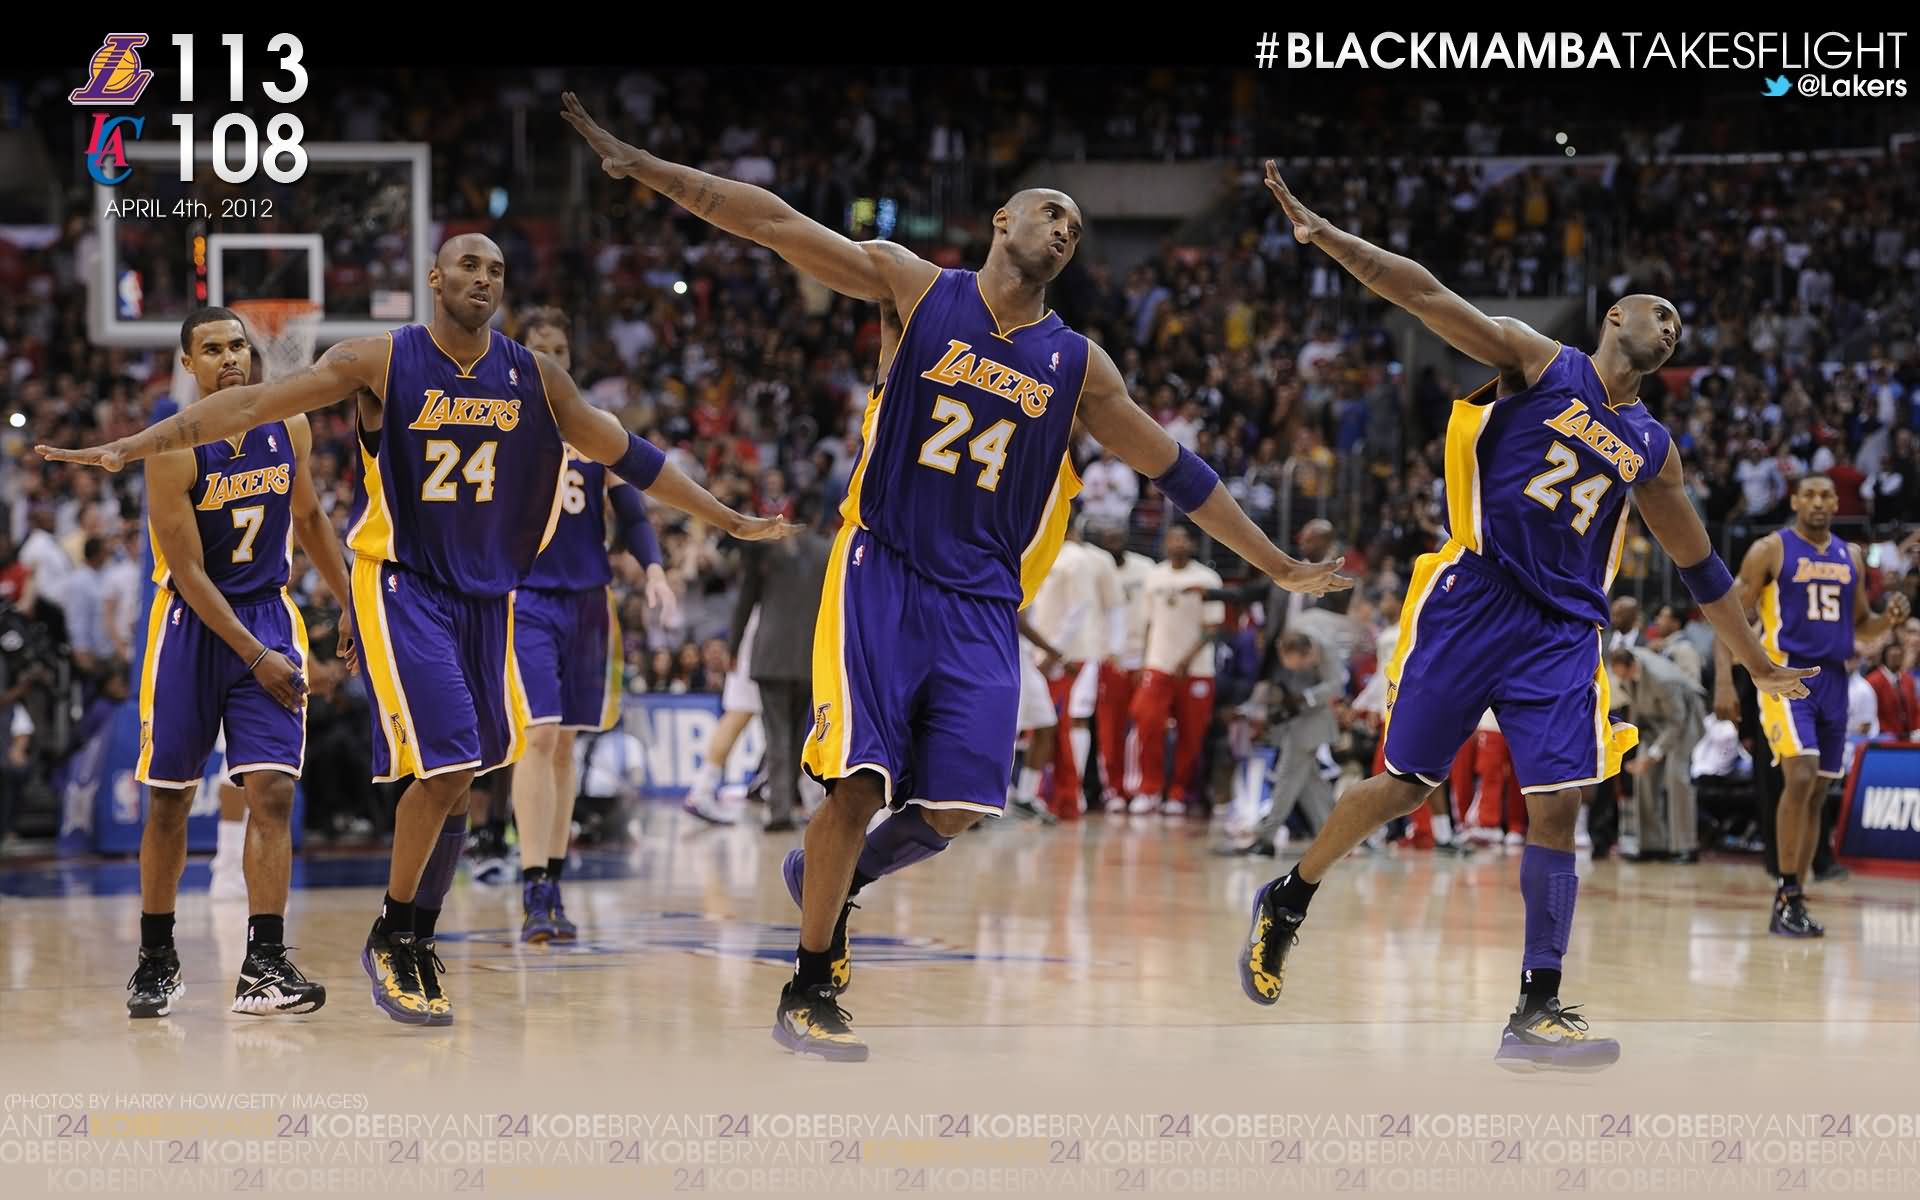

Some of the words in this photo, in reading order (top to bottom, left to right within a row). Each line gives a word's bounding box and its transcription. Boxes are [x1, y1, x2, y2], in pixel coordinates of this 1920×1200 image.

[408, 389, 523, 432] LAKERS
[920, 339, 1055, 418] LAKERS
[422, 439, 498, 503] 24
[917, 394, 1017, 492] 24
[1543, 398, 1645, 483] LAKERS
[196, 463, 290, 511] LAKERS
[1523, 440, 1613, 536] 24
[231, 505, 264, 564] 7
[1807, 583, 1841, 622] 15
[623, 706, 767, 788] NBA
